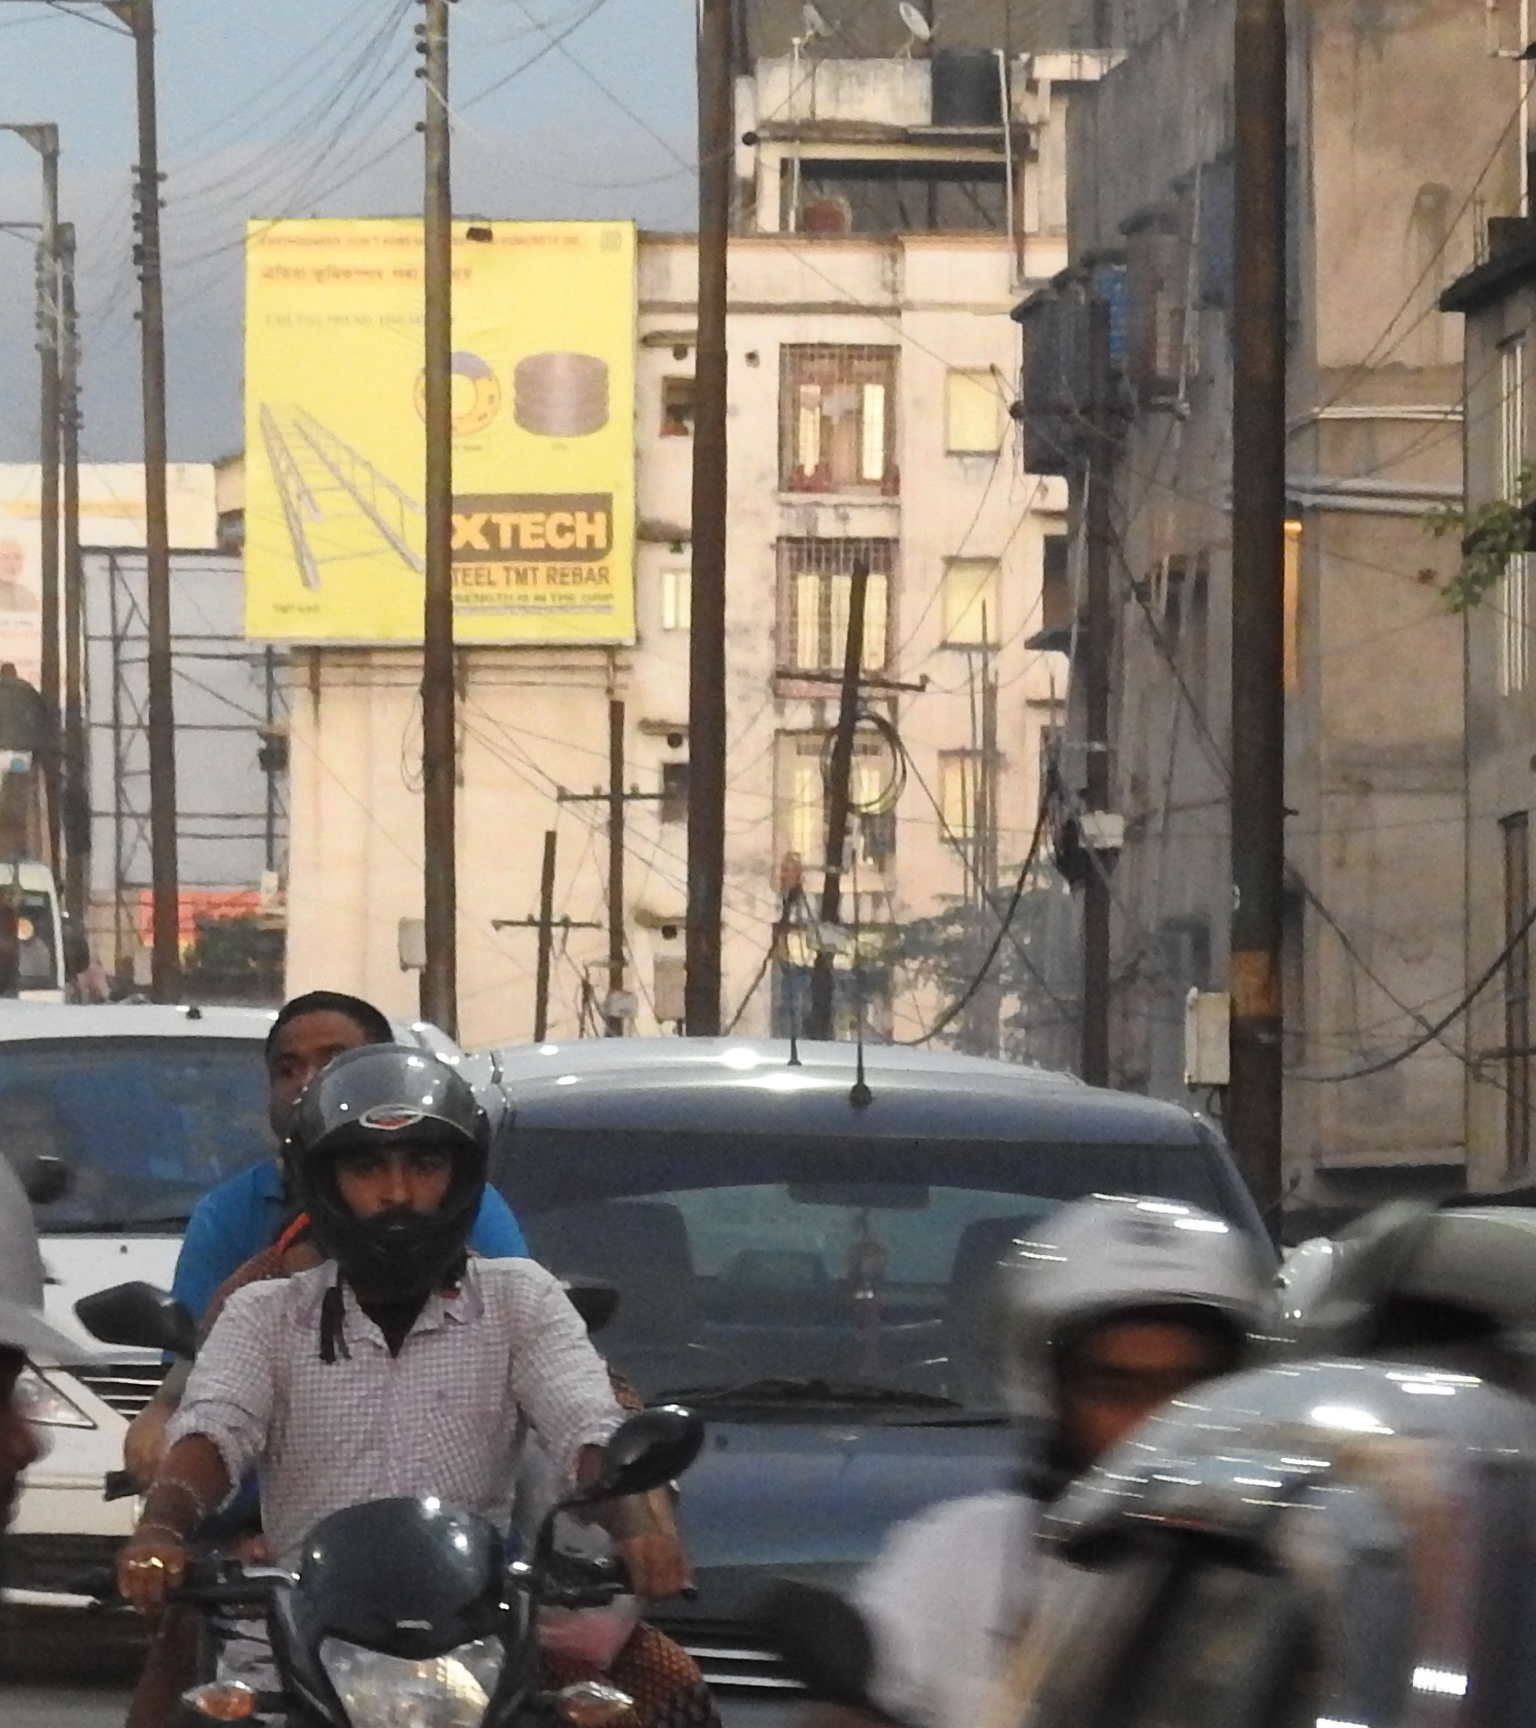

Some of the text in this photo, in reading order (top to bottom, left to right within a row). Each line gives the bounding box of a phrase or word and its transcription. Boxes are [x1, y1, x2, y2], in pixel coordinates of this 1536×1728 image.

[452, 512, 608, 550] XTECH
[504, 566, 539, 586] TMT
[545, 565, 611, 586] REBAR
